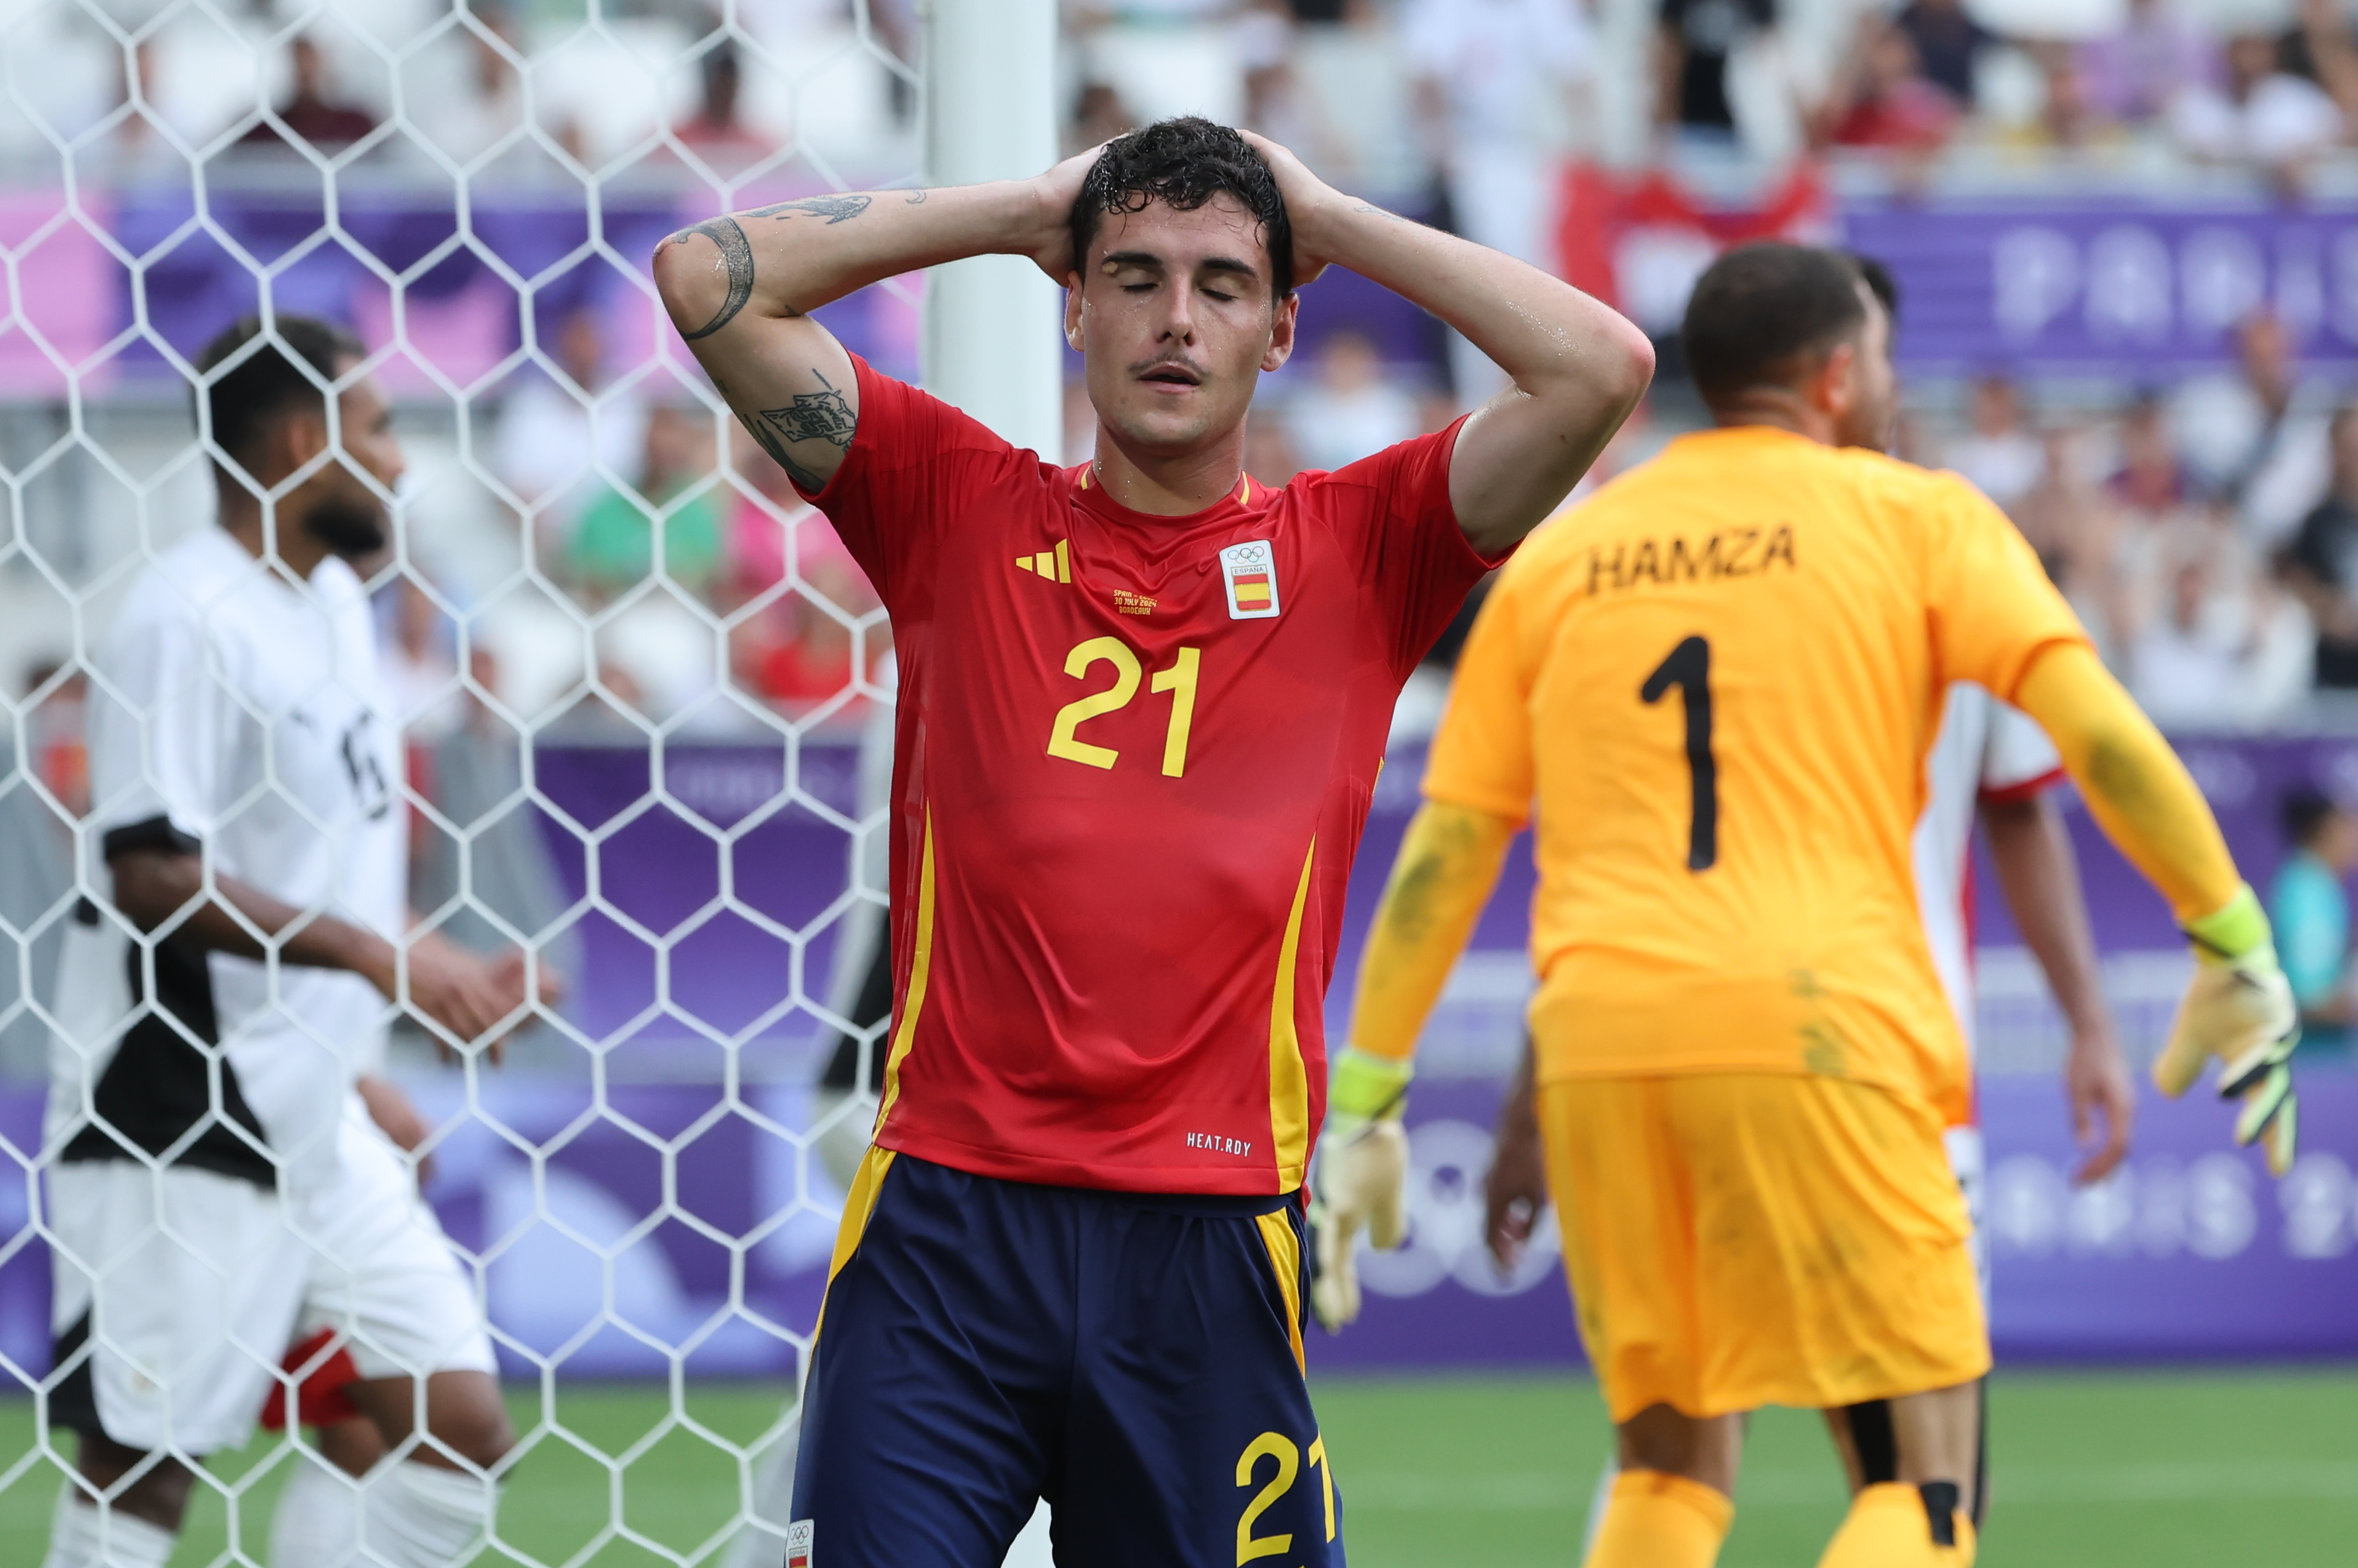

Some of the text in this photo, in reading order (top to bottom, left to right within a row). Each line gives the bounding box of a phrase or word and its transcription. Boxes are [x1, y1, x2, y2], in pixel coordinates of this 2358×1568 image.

[1586, 525, 1797, 596] HAMZA
[1113, 589, 1132, 598] SPAIN
[1114, 597, 1157, 608] 30 JULY 2024
[1119, 606, 1151, 615] BORDEAUX
[1047, 636, 1201, 779] 21
[1640, 635, 1718, 871] 1
[1187, 1132, 1251, 1157] HEAT.RDY
[1236, 1430, 1336, 1568] 21
